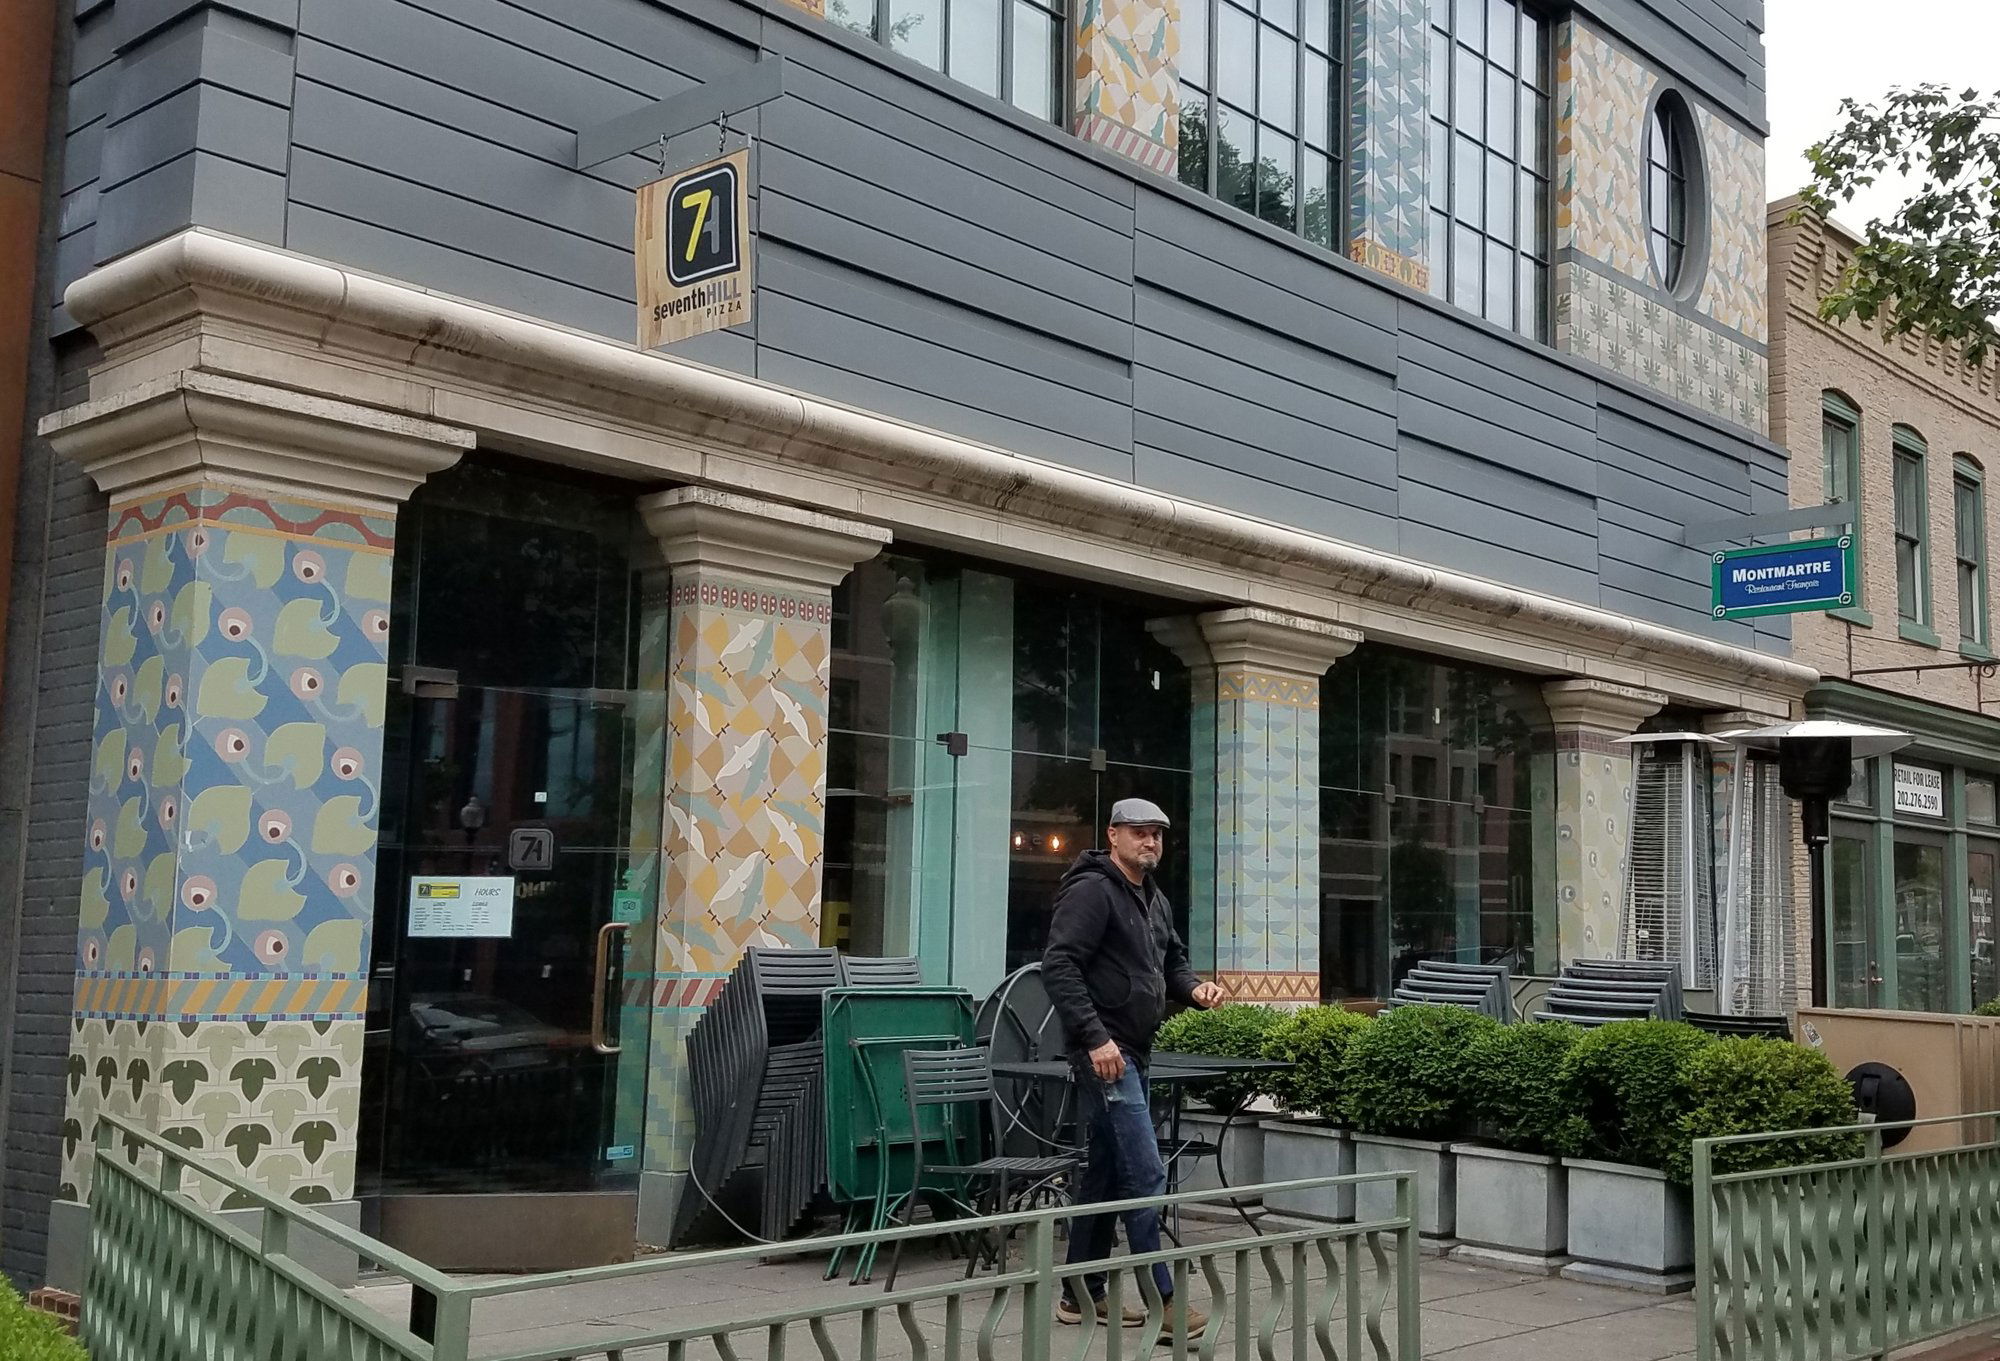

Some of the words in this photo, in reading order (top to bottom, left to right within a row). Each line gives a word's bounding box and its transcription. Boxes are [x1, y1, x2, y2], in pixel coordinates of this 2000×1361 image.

[706, 300, 742, 318] PIZZA
[1744, 583, 1785, 594] Restaurant
[1894, 769, 1912, 785] RETAIL
[1913, 771, 1924, 787] FOR
[1925, 773, 1940, 790] LEASE
[1897, 790, 1938, 810] 202.276.2590
[474, 888, 501, 897] HOURS
